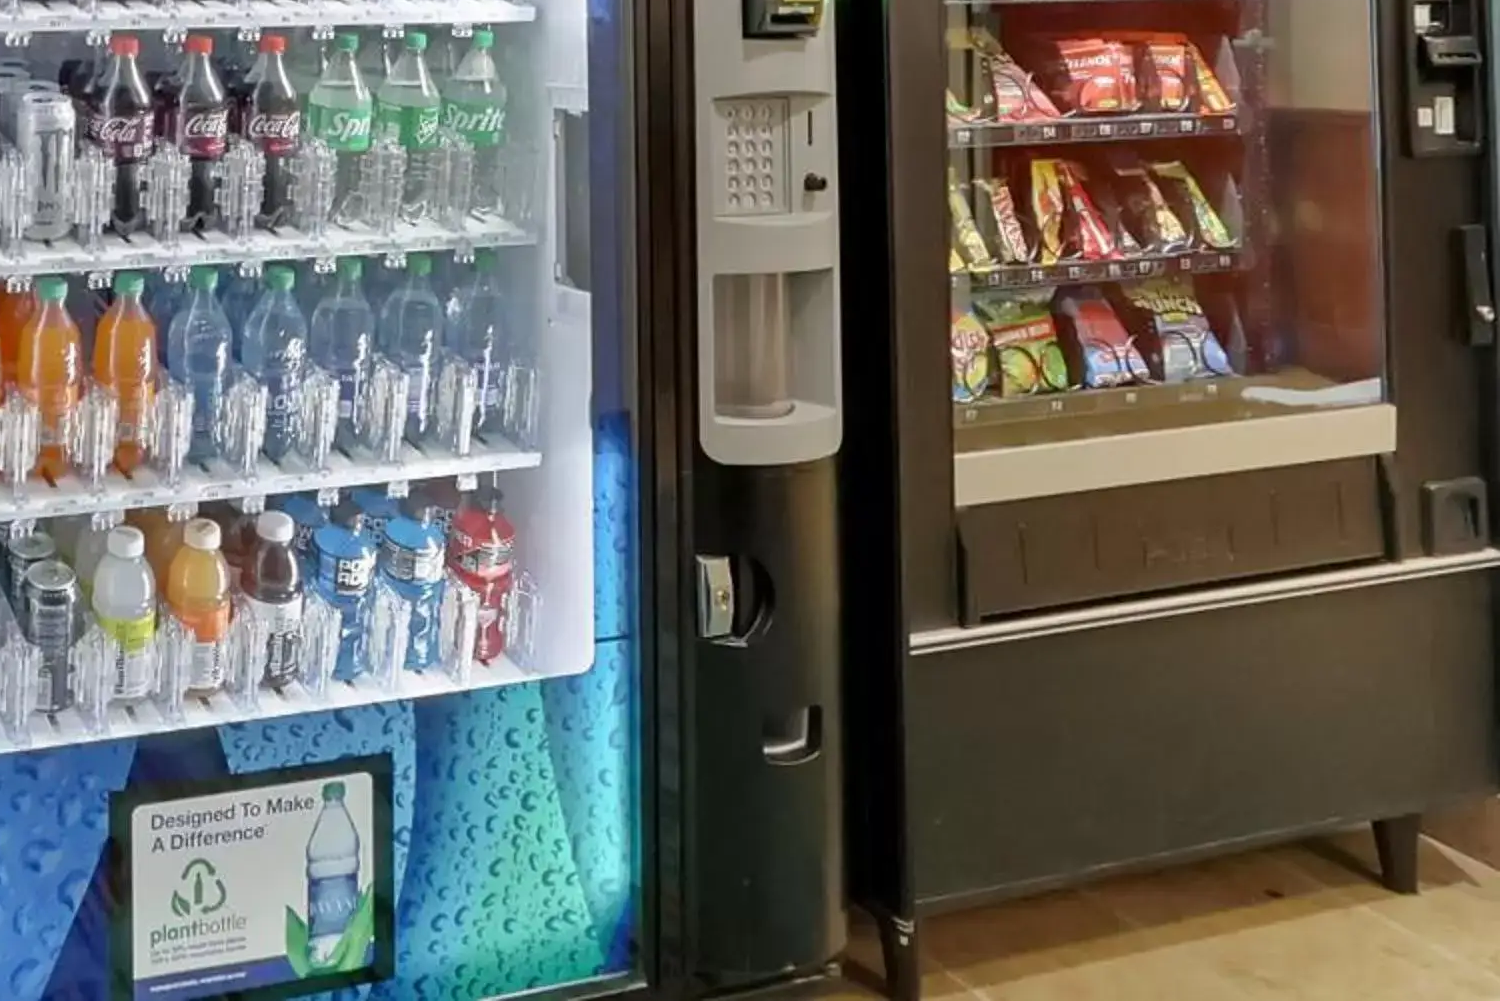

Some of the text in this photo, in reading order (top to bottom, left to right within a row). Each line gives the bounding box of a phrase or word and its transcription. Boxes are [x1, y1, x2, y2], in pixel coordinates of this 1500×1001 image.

[151, 795, 315, 831] Designed To Make
[152, 825, 266, 853] A Difference
